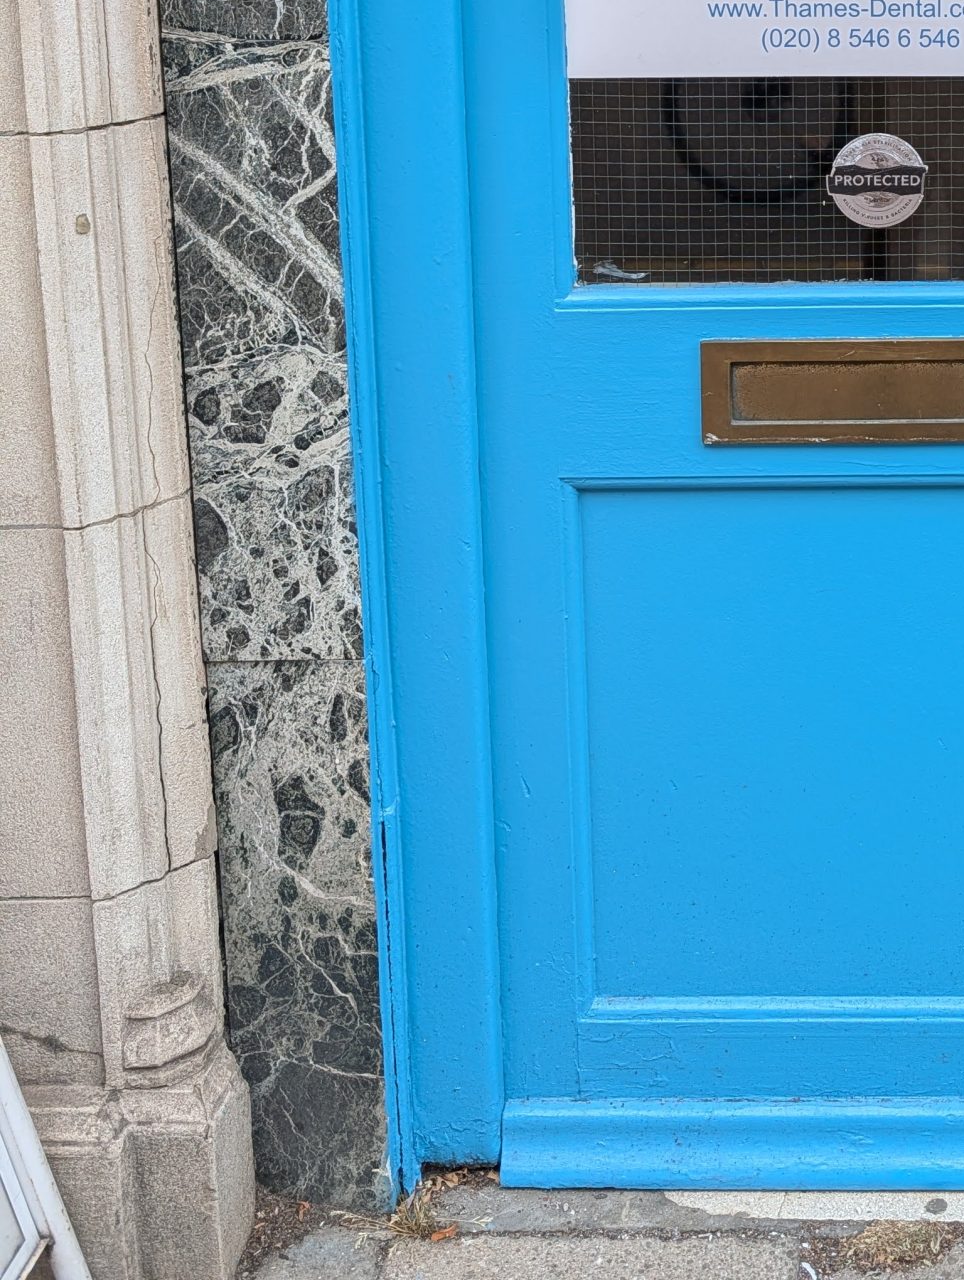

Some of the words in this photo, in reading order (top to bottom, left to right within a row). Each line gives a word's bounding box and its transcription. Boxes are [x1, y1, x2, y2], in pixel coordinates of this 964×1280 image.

[761, 28, 820, 53] (020)
[827, 28, 841, 48] 8
[848, 28, 890, 48] 546
[897, 28, 911, 48] 6
[918, 28, 961, 48] 546
[834, 174, 921, 187] PROTECTED
